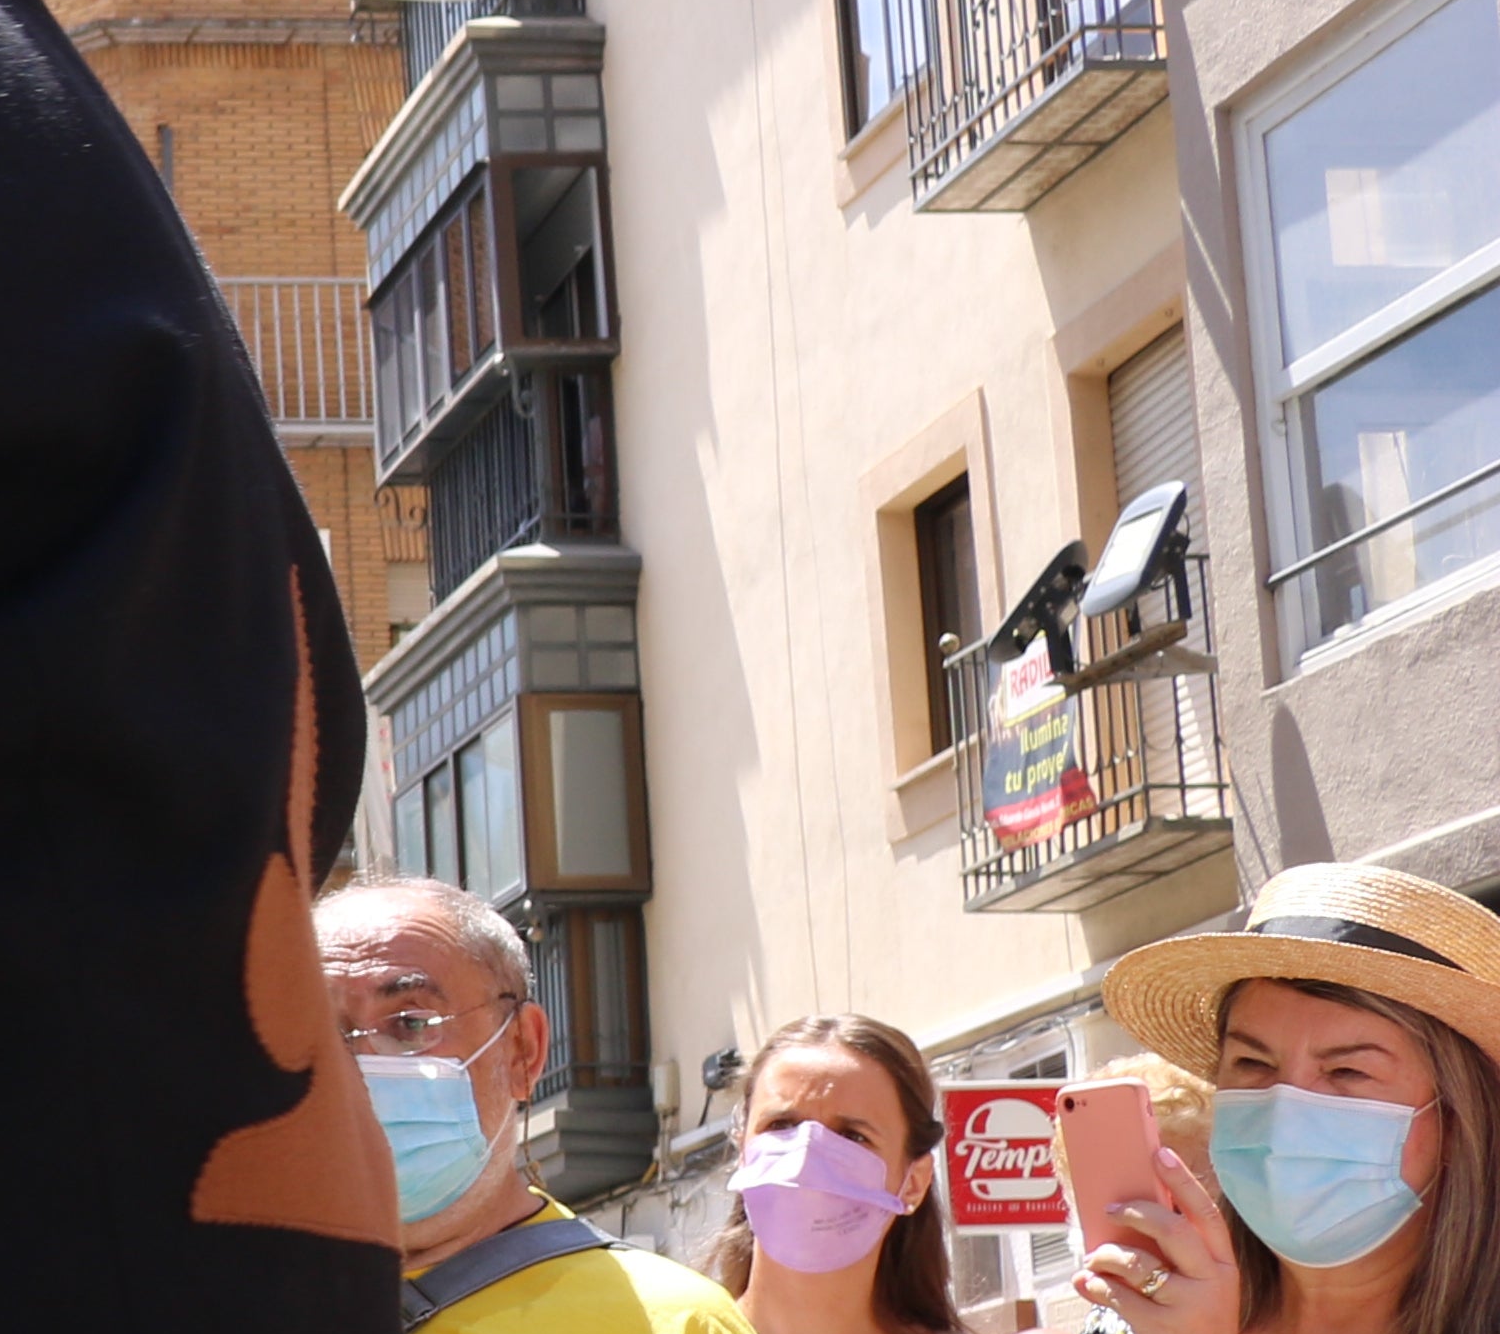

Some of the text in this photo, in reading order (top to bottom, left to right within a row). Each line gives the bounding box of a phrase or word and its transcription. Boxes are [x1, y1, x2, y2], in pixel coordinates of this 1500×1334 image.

[1004, 740, 1068, 795] tu proye
[954, 1138, 1052, 1178] Temp
